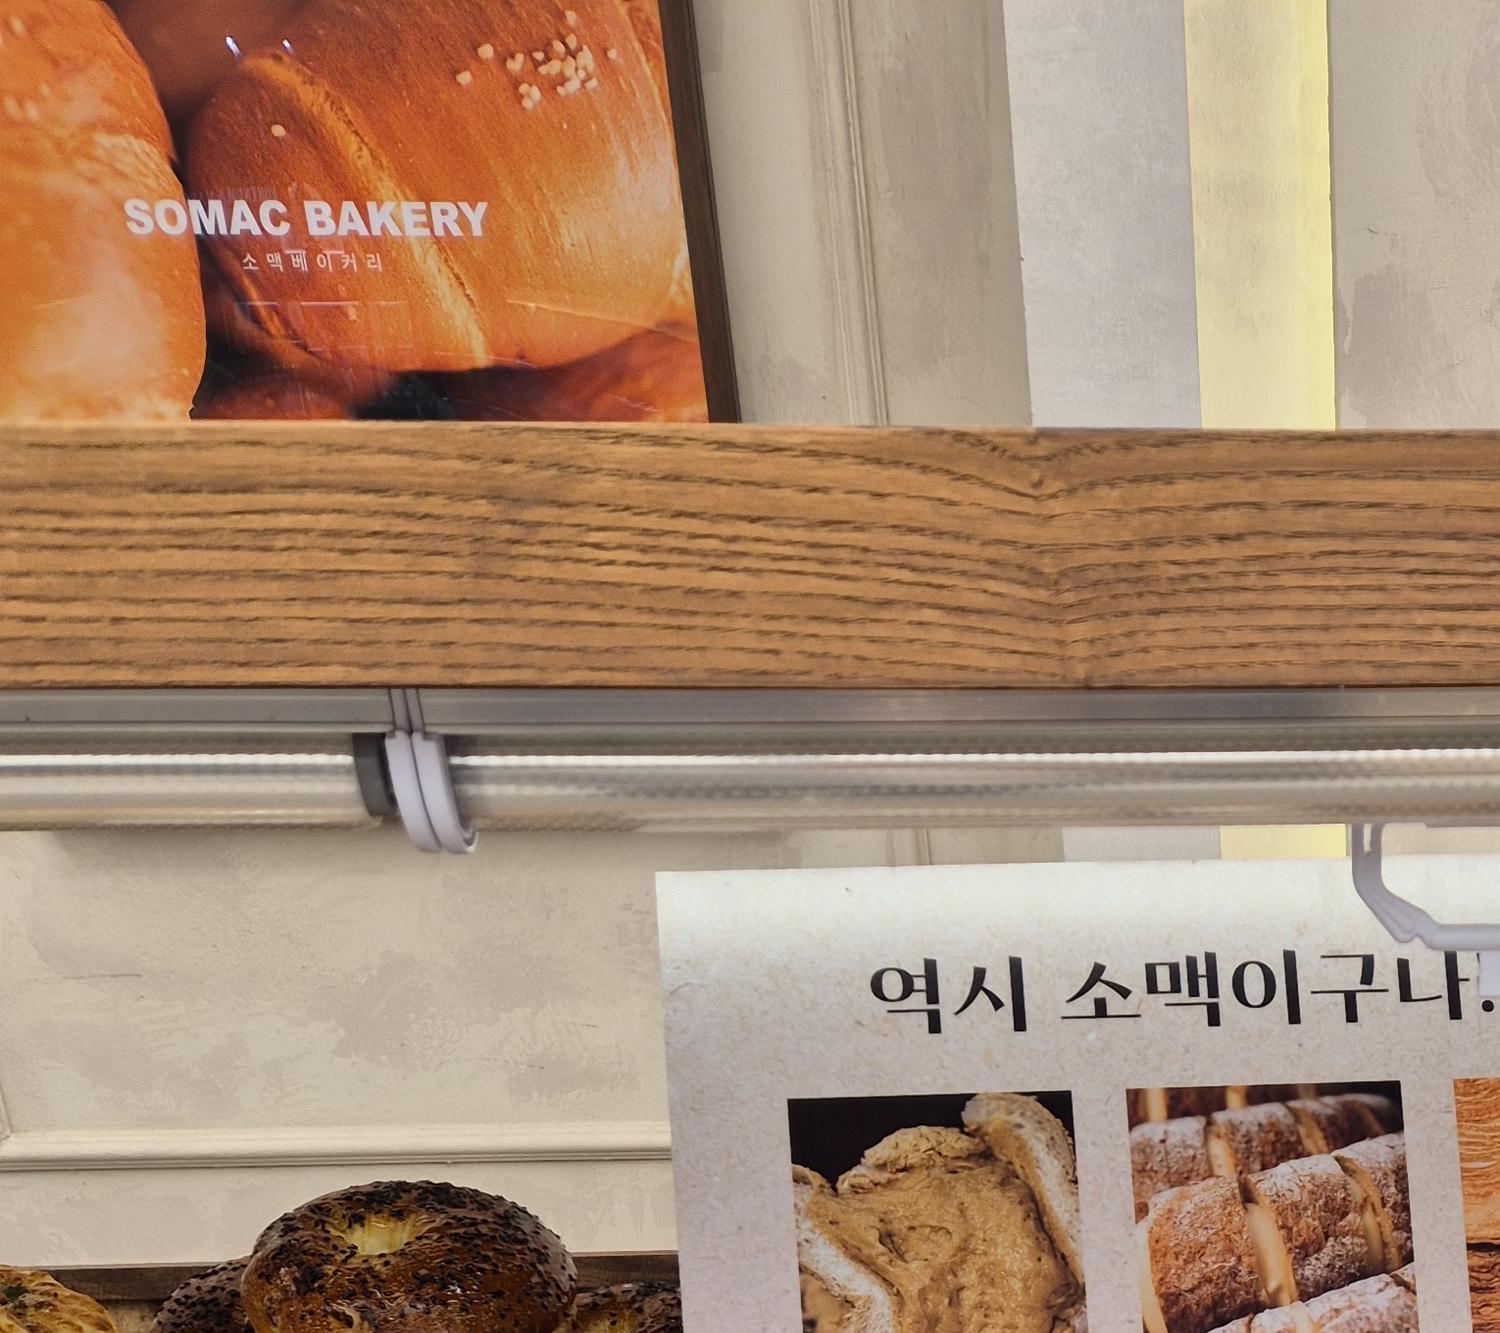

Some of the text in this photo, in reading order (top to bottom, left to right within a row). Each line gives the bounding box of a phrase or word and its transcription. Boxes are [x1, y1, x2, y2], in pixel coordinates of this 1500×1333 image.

[123, 198, 489, 238] SOMAC BAKERY
[242, 251, 383, 274] 소맥베이커리
[870, 955, 1028, 1034] 역시
